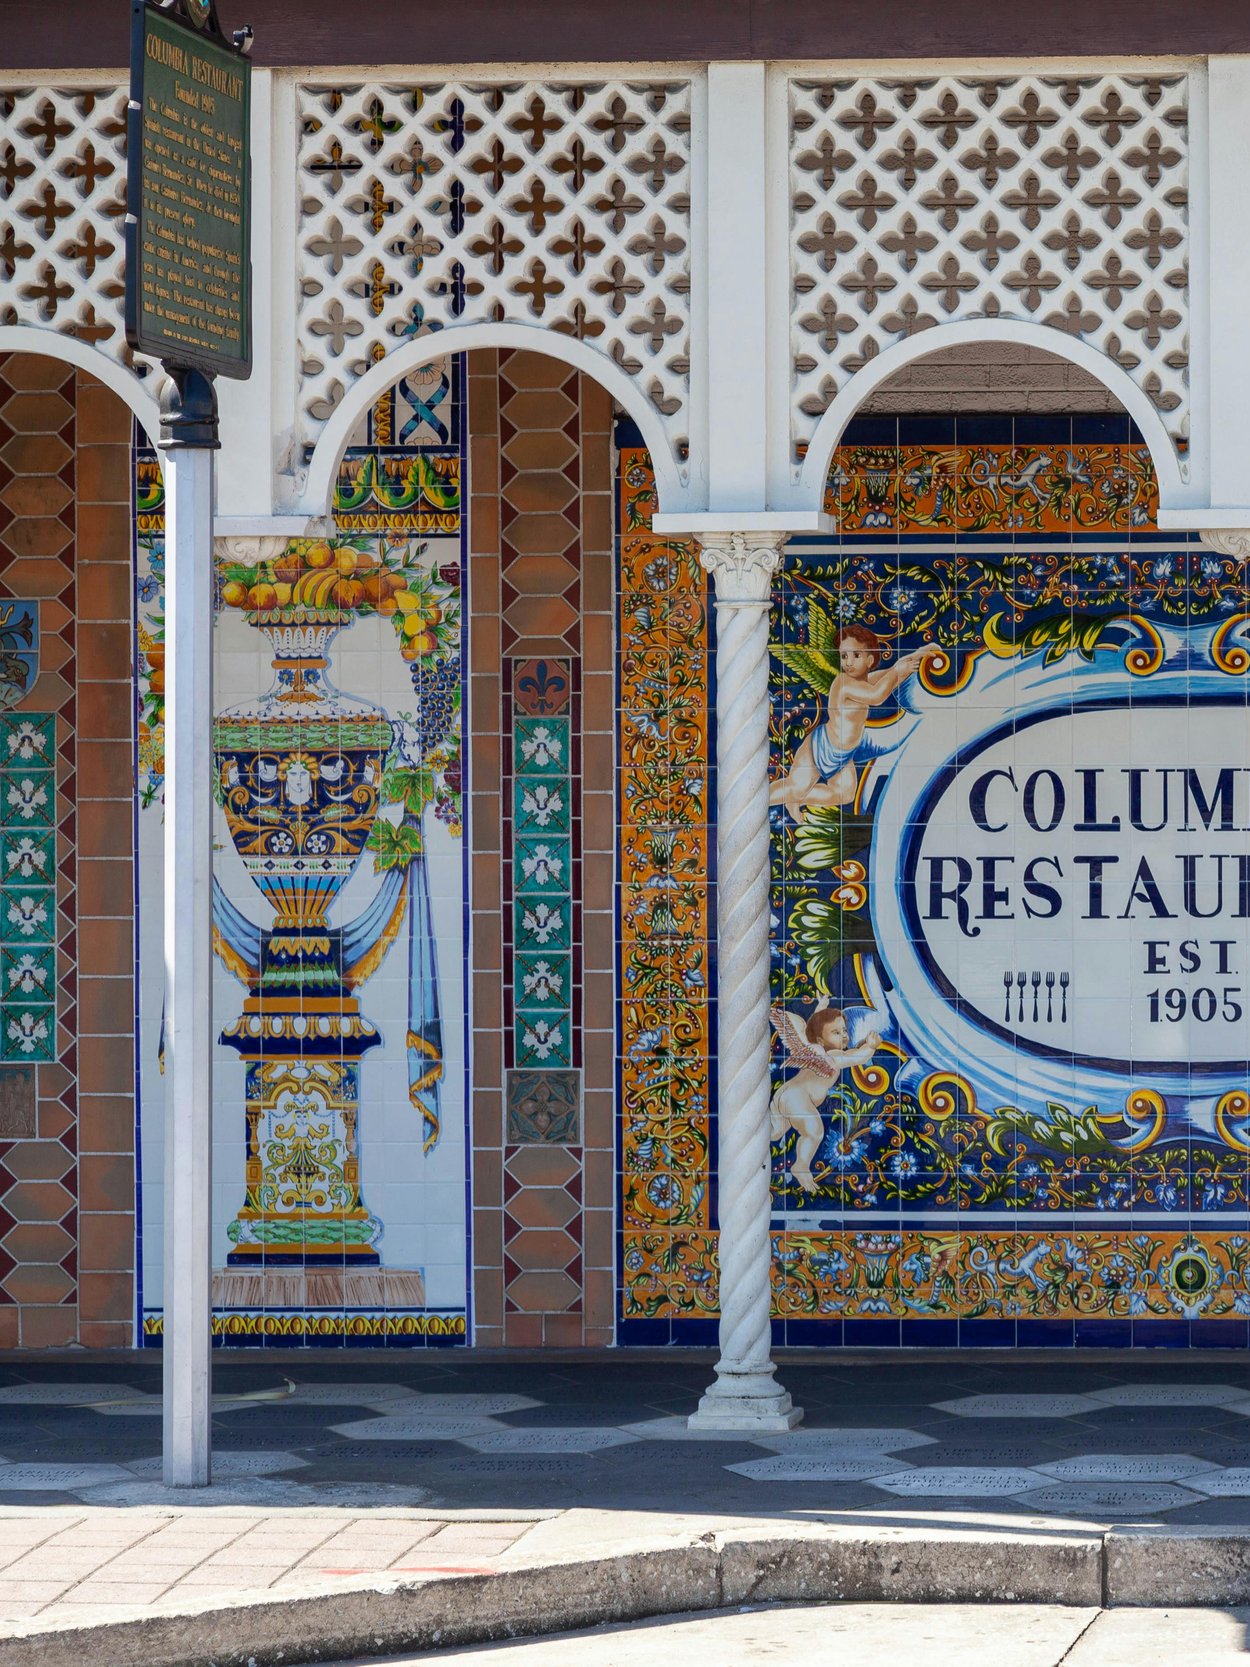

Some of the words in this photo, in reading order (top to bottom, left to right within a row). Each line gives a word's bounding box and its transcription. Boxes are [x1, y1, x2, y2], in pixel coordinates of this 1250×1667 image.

[146, 33, 189, 76] COLUMBIA
[192, 56, 244, 101] RESTAURANT
[175, 80, 199, 109] Founded
[1143, 939, 1239, 974] EST.
